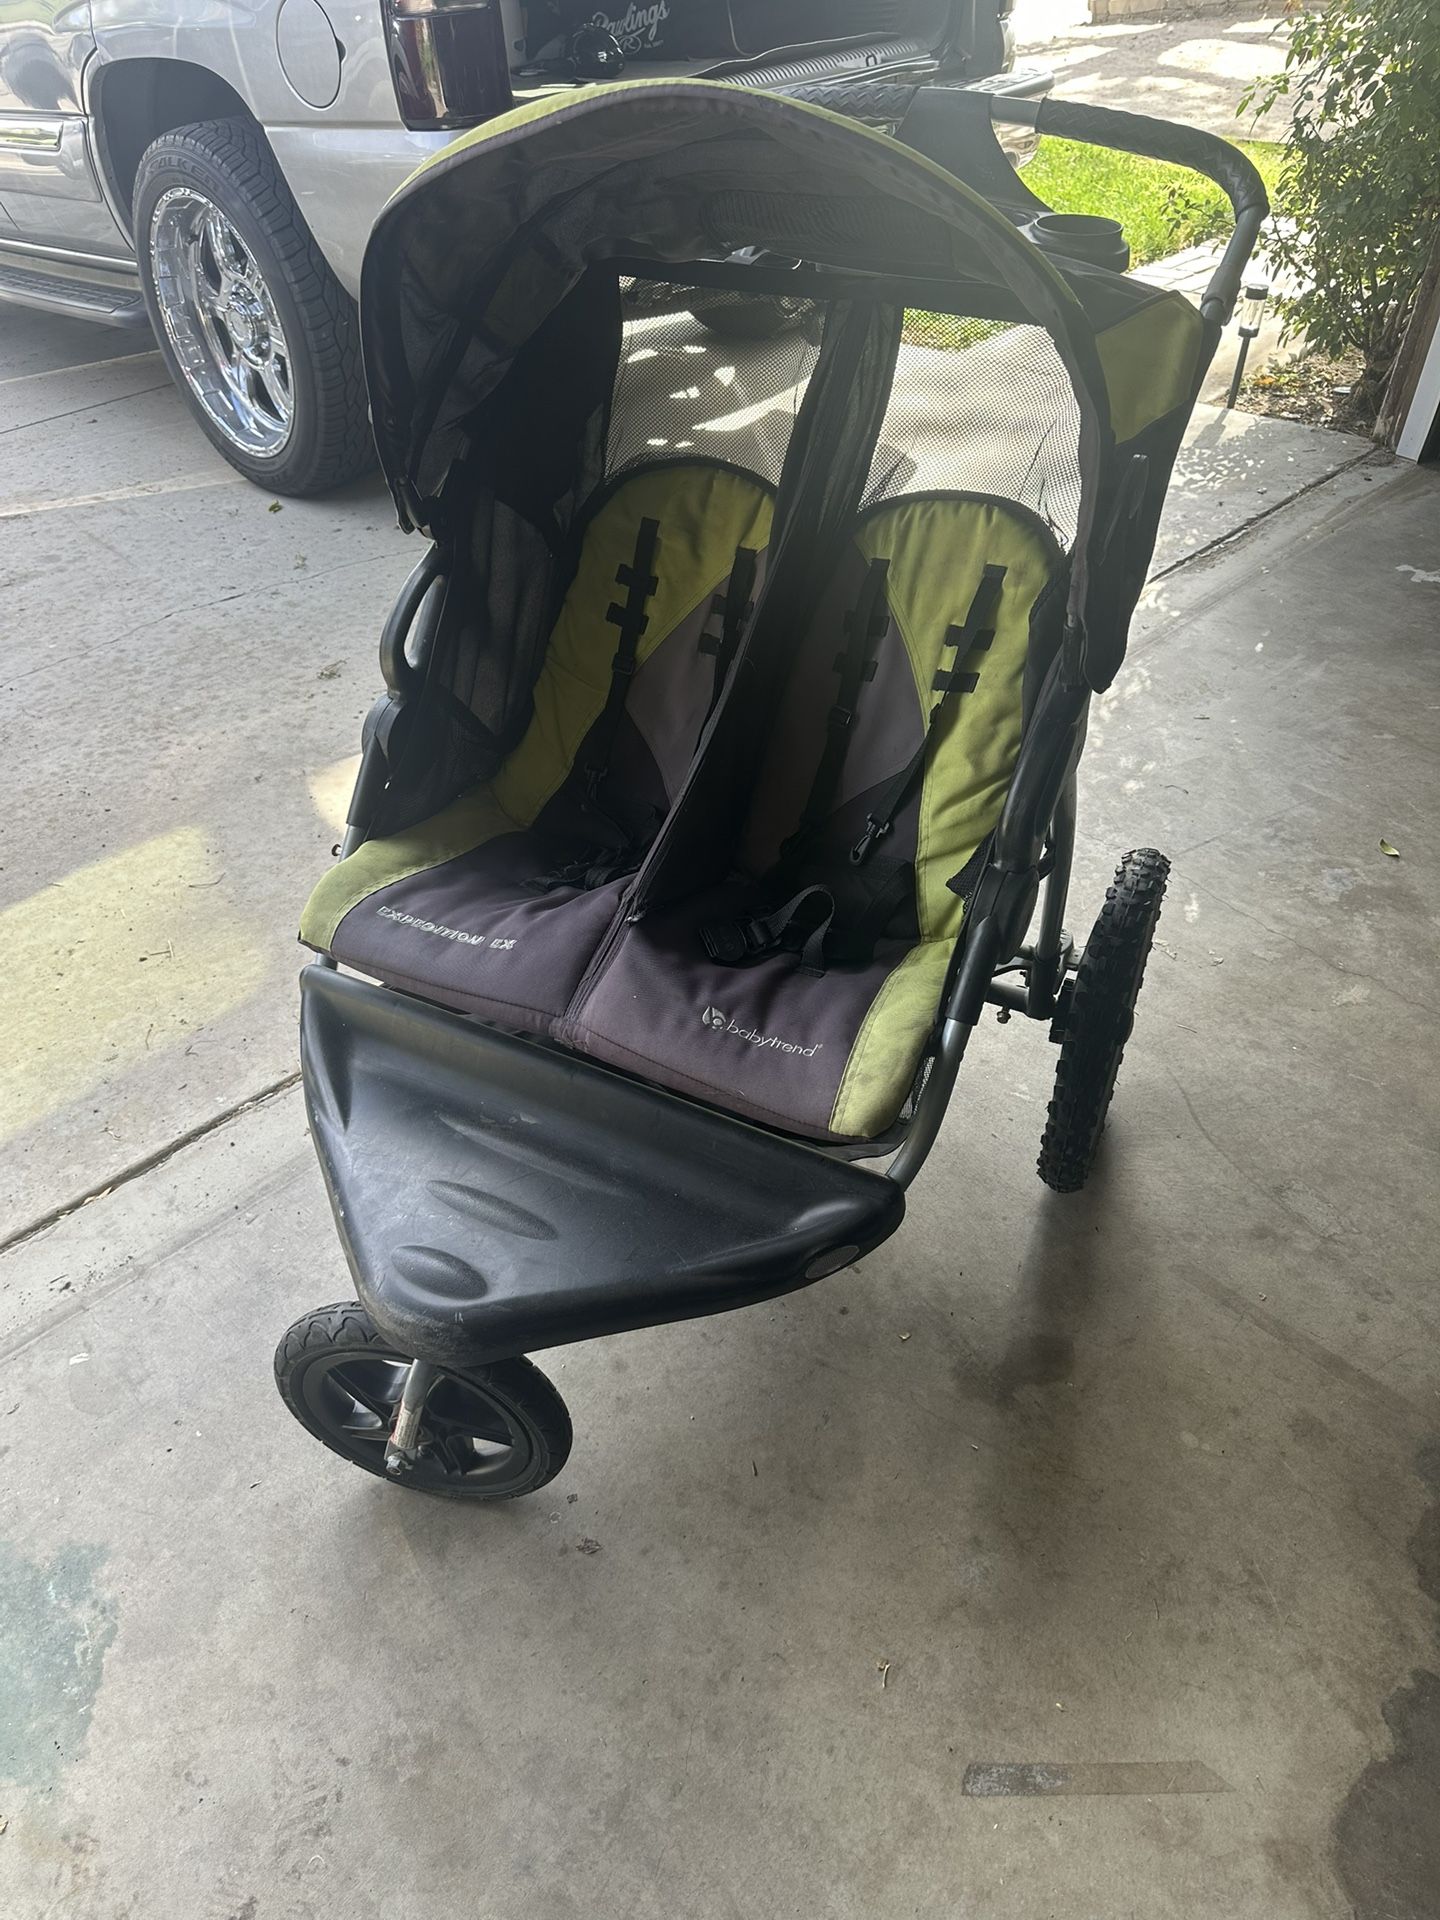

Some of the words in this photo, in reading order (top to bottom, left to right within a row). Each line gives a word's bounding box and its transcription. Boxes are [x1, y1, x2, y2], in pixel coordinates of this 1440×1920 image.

[592, 0, 670, 41] Rawlings
[376, 905, 485, 946] EXPEDITION
[489, 938, 518, 950] EX
[726, 1019, 821, 1057] babytrend
